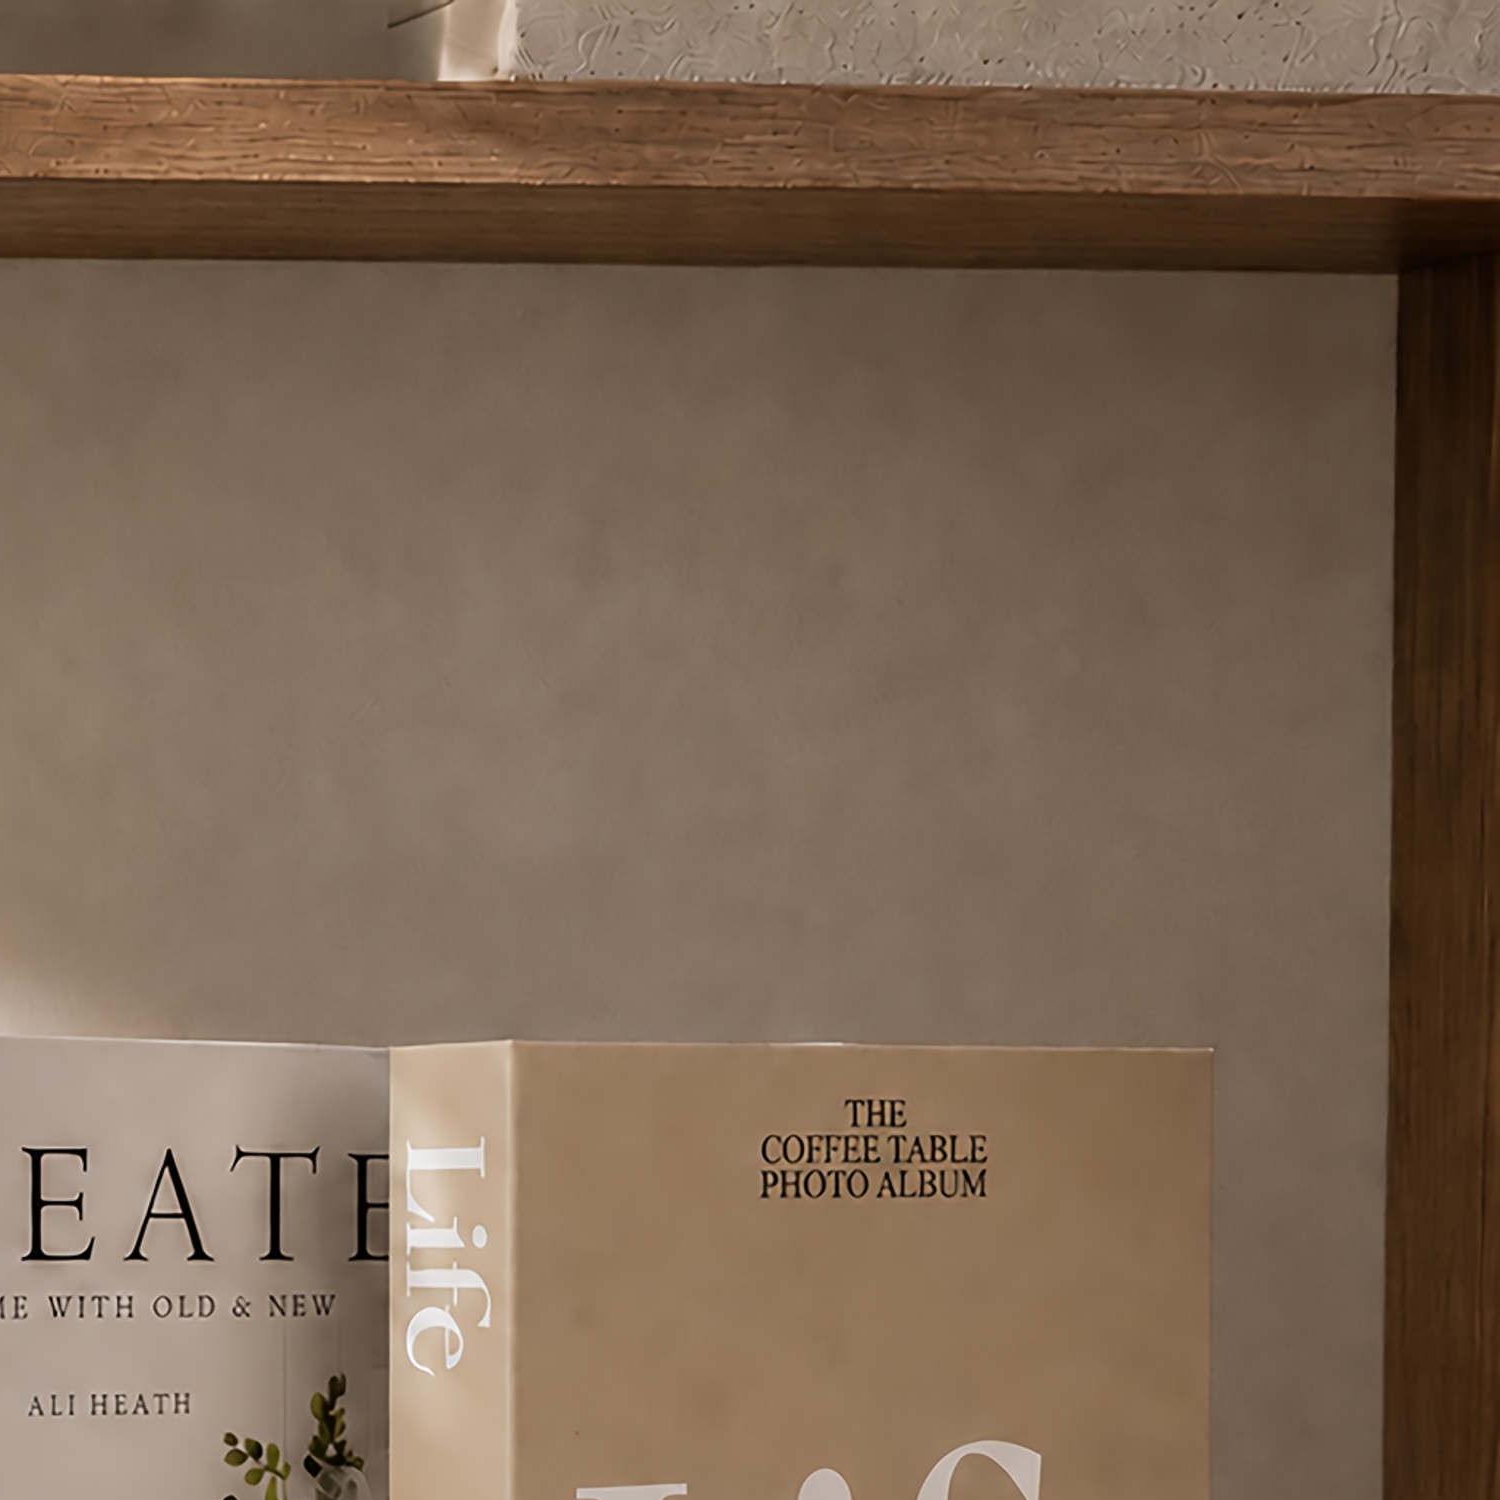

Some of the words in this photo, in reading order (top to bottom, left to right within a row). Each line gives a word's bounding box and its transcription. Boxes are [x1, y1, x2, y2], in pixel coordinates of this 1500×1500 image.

[844, 1099, 907, 1128] THE
[761, 1134, 881, 1164] COFFEE
[887, 1134, 988, 1164] TABLE
[761, 1169, 869, 1199] PHOTO
[876, 1168, 987, 1198] ALBUM
[405, 1136, 491, 1377] Life
[48, 1295, 134, 1320] WITH
[153, 1294, 216, 1318] OLD
[231, 1295, 252, 1318] &
[269, 1294, 337, 1317] NEW
[28, 1394, 76, 1417] ALI
[91, 1392, 191, 1416] HEATH
